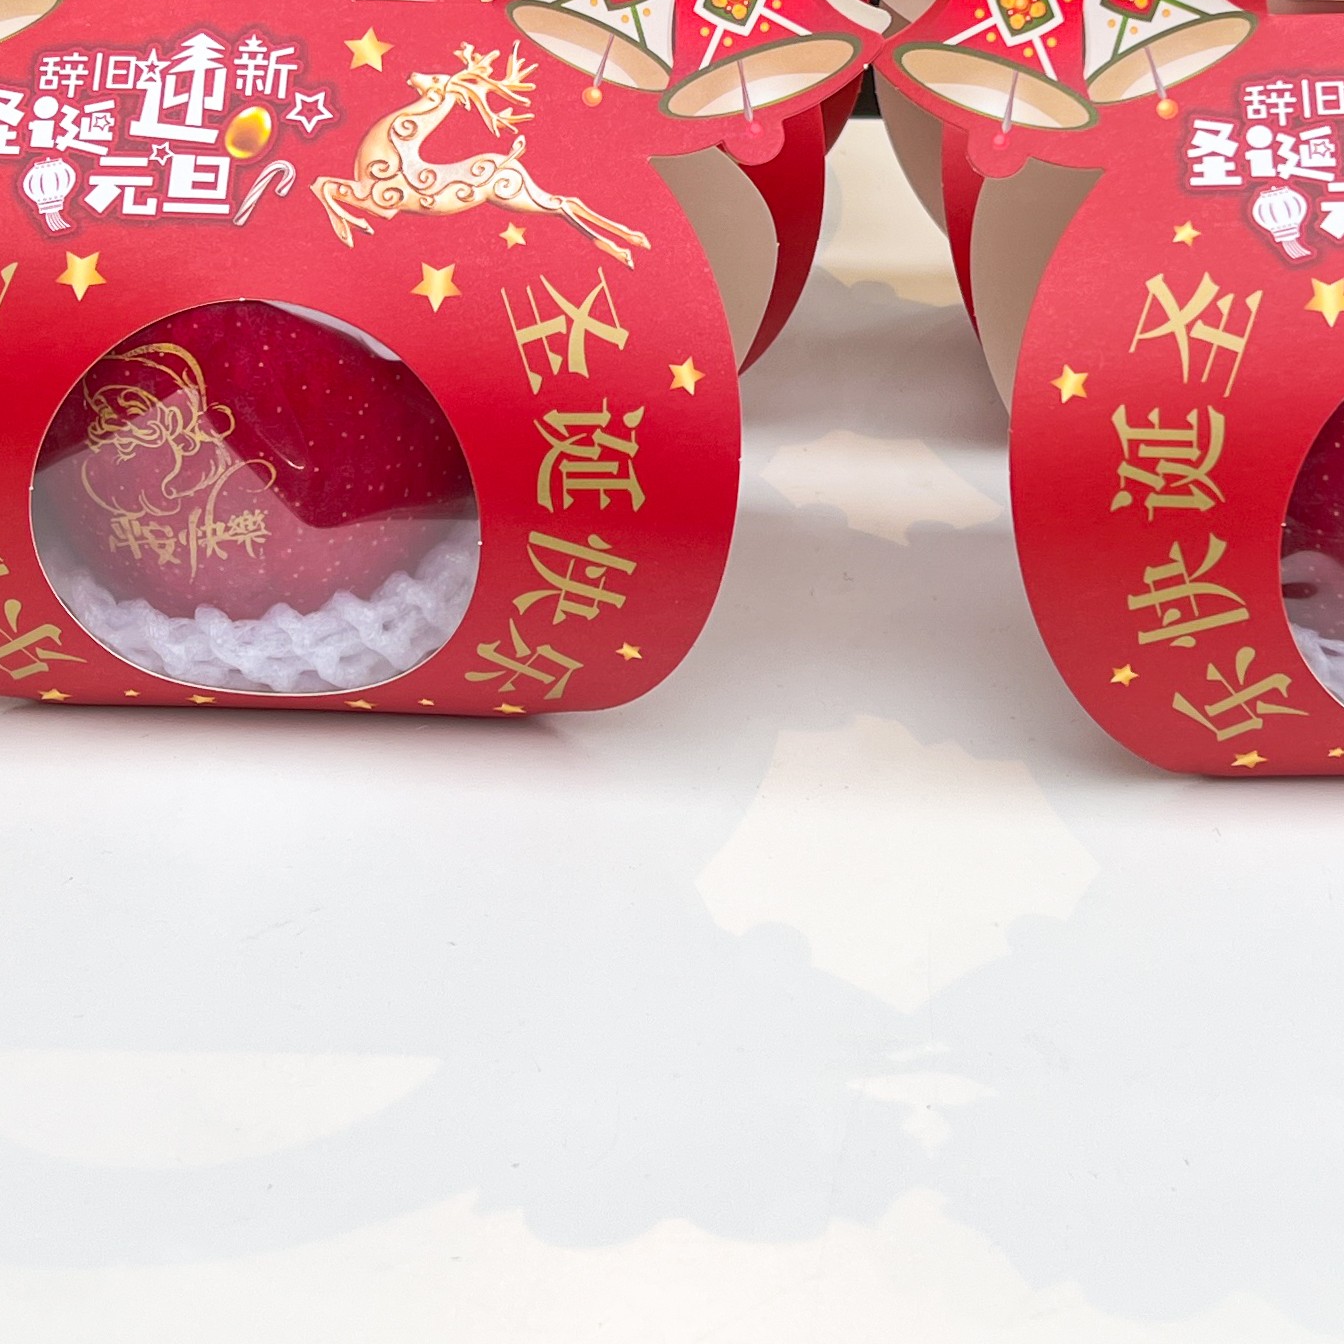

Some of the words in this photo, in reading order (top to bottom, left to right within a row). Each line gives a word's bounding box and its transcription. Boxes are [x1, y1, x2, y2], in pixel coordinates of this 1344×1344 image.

[39, 32, 299, 144] 辞旧迎新
[84, 154, 231, 216] 元旦
[1187, 119, 1337, 186] 圣诞
[464, 266, 647, 701] 圣诞快乐
[1109, 270, 1309, 743] 圣诞快乐
